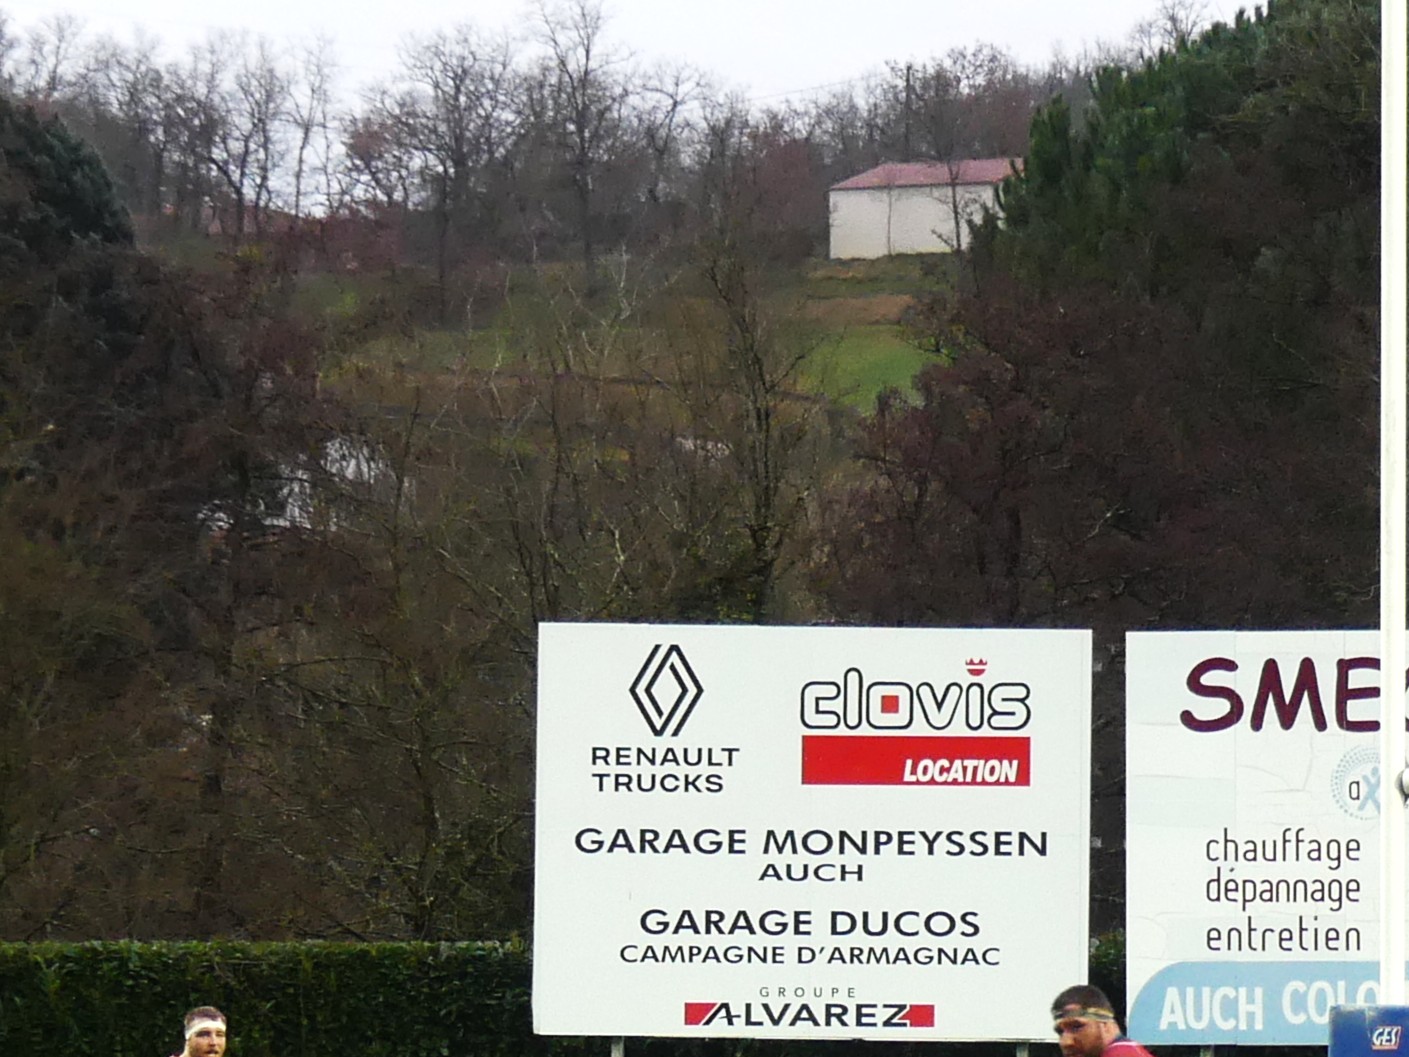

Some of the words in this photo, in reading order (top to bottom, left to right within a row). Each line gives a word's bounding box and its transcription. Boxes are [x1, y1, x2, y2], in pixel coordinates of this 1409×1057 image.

[800, 667, 1031, 731] clovis
[591, 747, 740, 767] RENAULT
[903, 758, 1018, 783] LOCATION
[592, 774, 724, 793] TRUCKS
[574, 827, 747, 855] GARAGE
[762, 829, 1048, 857] MONPEYSSEN
[1205, 827, 1362, 871] chauffage
[758, 863, 864, 882] AUCH
[1205, 867, 1362, 912] dépannage
[639, 908, 813, 937] GARAGE
[830, 910, 981, 938] DUCOS
[1206, 915, 1362, 952] entretien
[620, 944, 786, 965] CAMPAGNE
[797, 945, 1001, 967] D'ARMAGNAC
[759, 986, 857, 999] GROUPE
[702, 1002, 912, 1028] ALVAREZ
[1159, 986, 1264, 1031] AUCH
